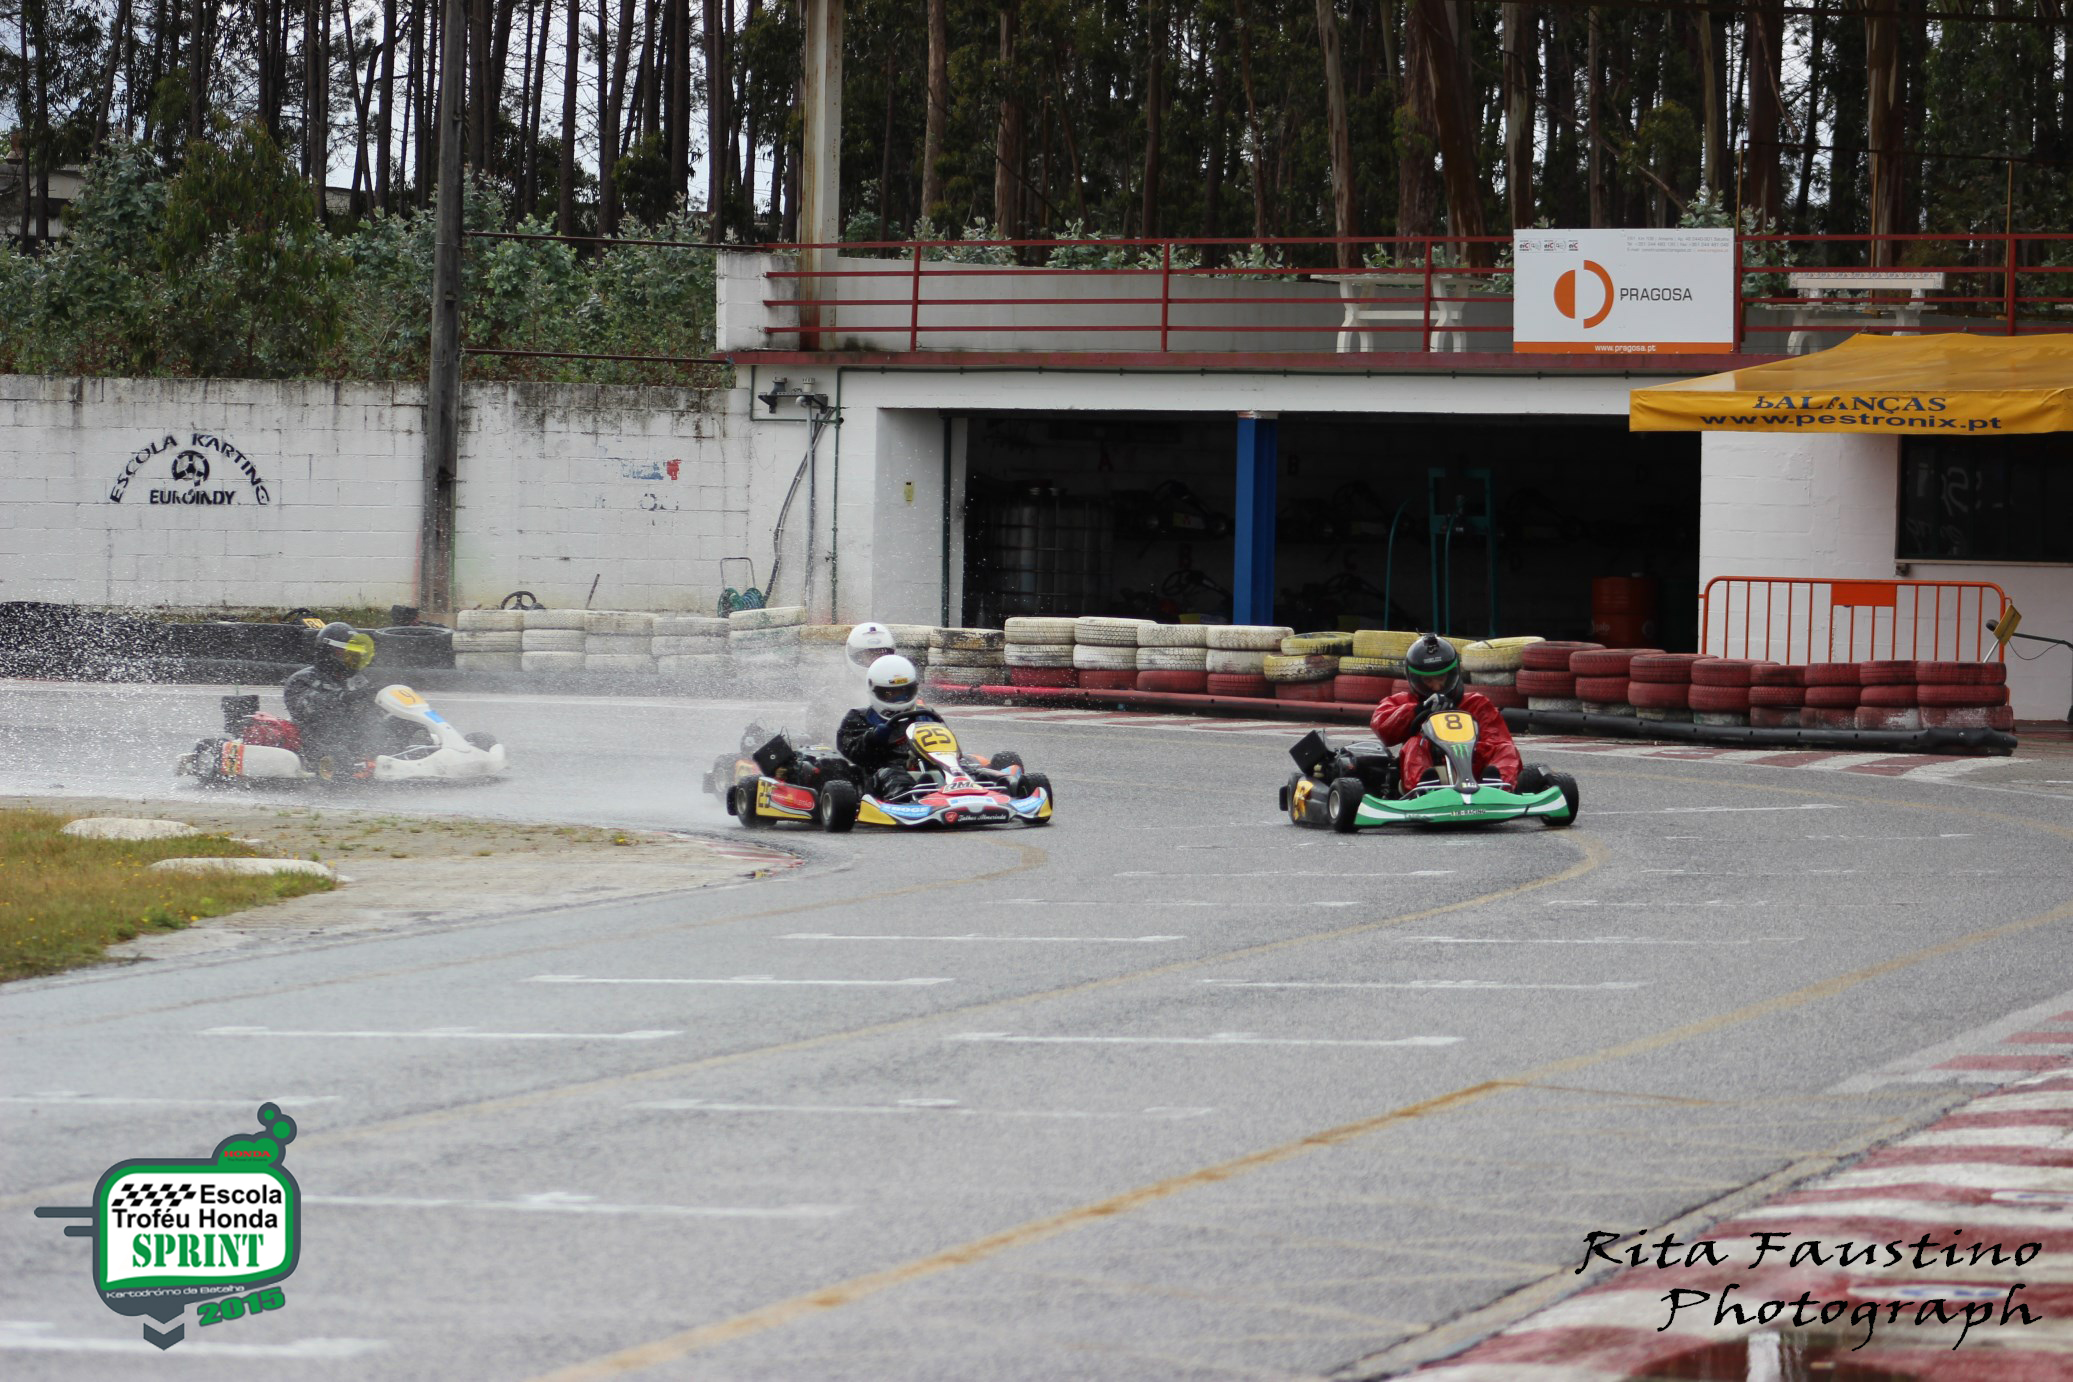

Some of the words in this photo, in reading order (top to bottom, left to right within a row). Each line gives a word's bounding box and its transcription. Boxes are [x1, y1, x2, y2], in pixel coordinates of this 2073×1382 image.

[1620, 288, 1693, 301] PRAGOSA
[1594, 345, 1656, 353] www.pragosa.pt
[1701, 412, 2002, 431] www.pestronix.pt
[109, 434, 178, 503] ESCOLA
[191, 432, 270, 505] KARTING
[1445, 713, 1463, 730] 8
[916, 728, 951, 748] 25
